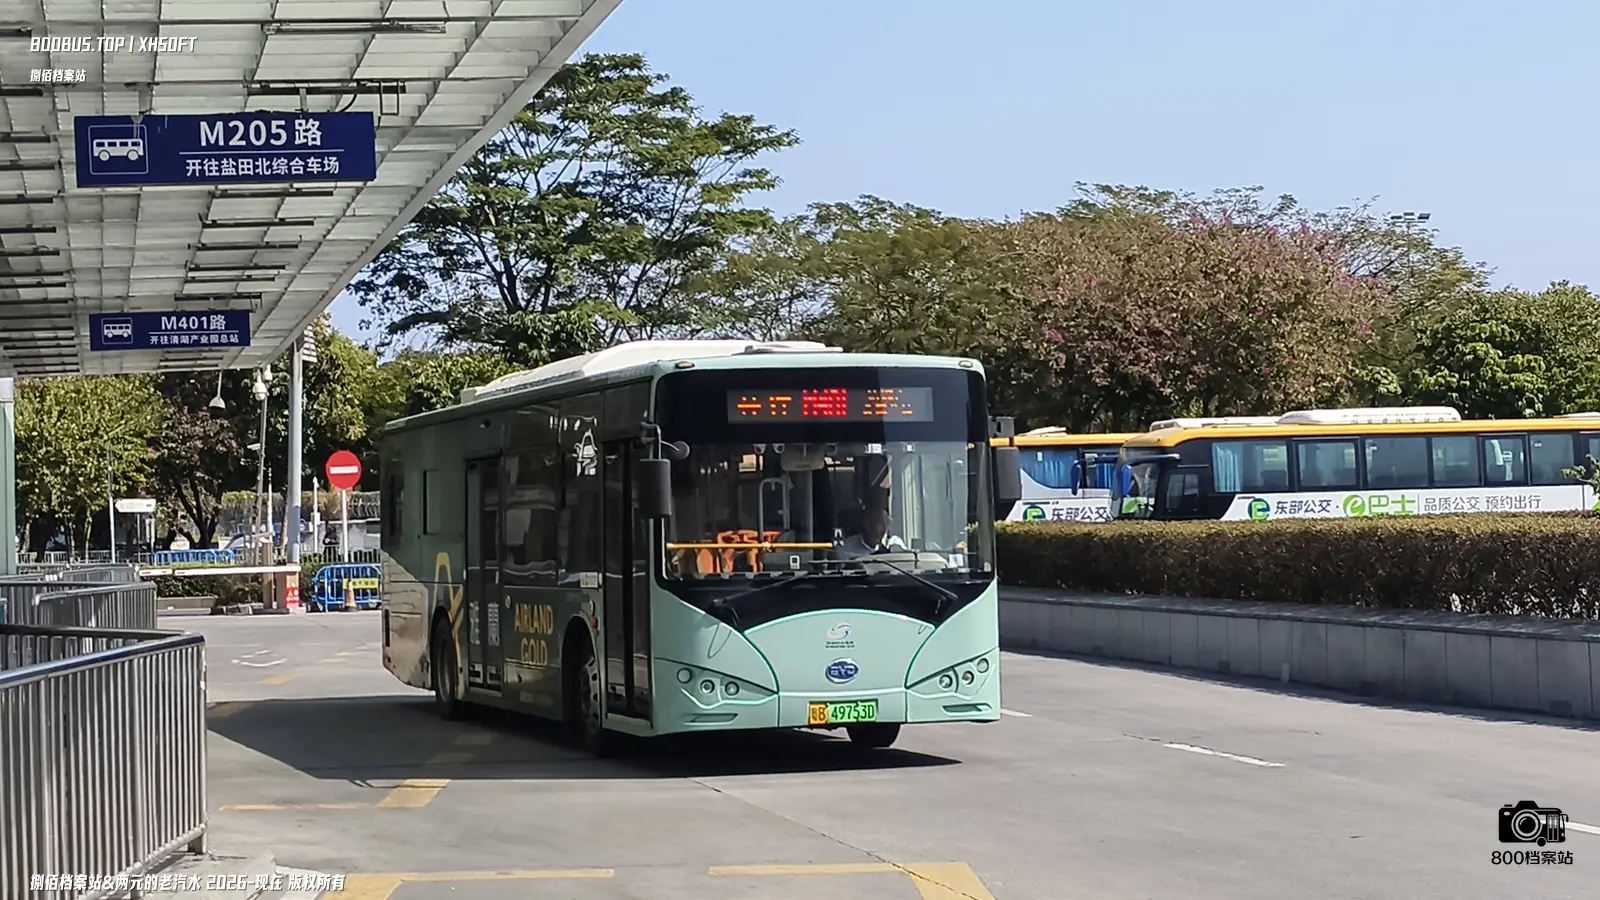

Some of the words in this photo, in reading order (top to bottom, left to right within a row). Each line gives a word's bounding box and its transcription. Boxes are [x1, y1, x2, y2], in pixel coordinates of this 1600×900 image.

[199, 118, 323, 148] M205路
[185, 157, 340, 177] 开往盐田北综合车场
[161, 314, 227, 331] M401路
[1051, 506, 1110, 521] 东部公交
[1274, 499, 1332, 515] 东部公交
[1424, 496, 1480, 512] 品质公交
[1485, 494, 1542, 511] 预约出行
[514, 603, 555, 635] AIRLAND
[520, 637, 549, 666] GOLD
[831, 704, 876, 721] 49753D
